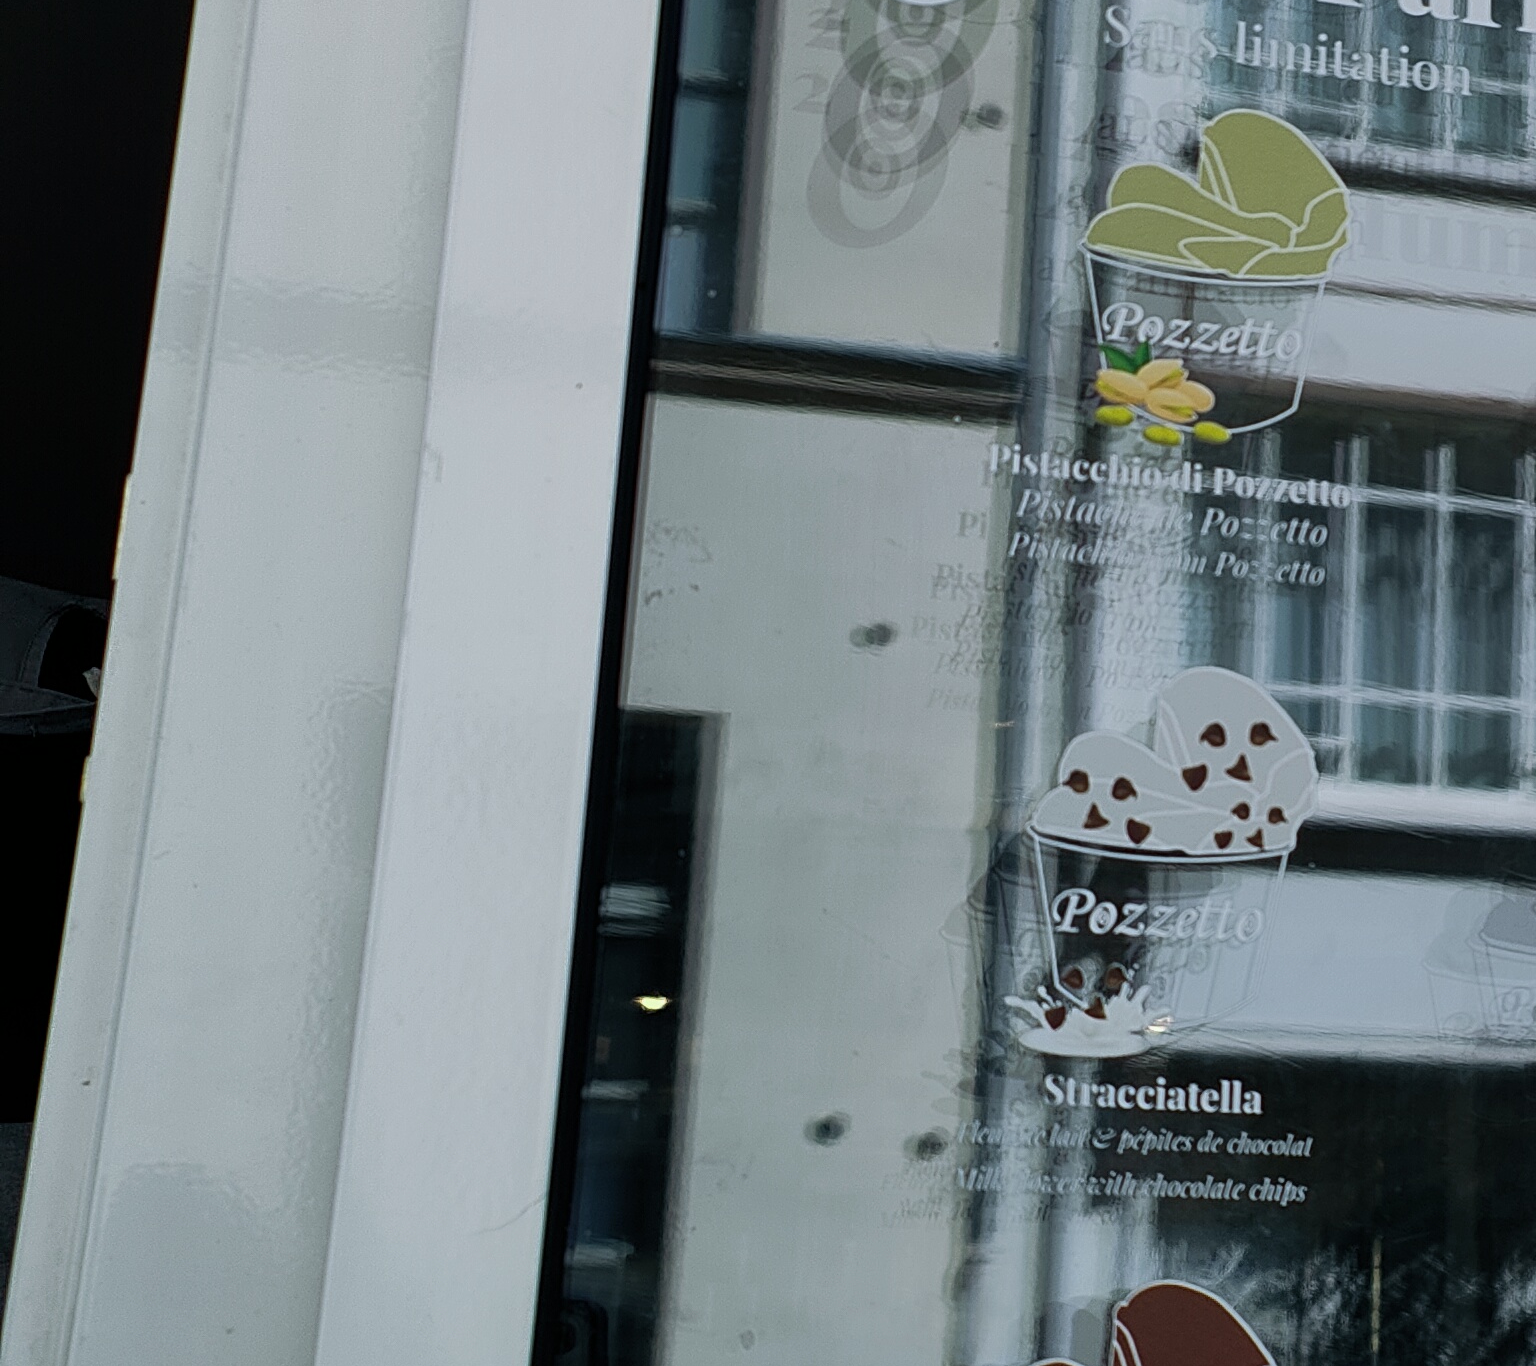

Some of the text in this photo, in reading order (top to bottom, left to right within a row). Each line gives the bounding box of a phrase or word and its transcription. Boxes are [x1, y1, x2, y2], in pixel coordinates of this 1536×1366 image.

[1233, 20, 1474, 97] limitation
[1101, 301, 1303, 362] Pozzetto
[988, 442, 1353, 510] Pistacchio di Pozzetto
[1051, 886, 1264, 944] Pozzetto
[1042, 1072, 1264, 1117] Stracciatella
[1117, 1125, 1195, 1157] pépites
[1196, 1129, 1224, 1154] de
[1226, 1131, 1314, 1159] chocolat
[1247, 1175, 1309, 1207] chips
